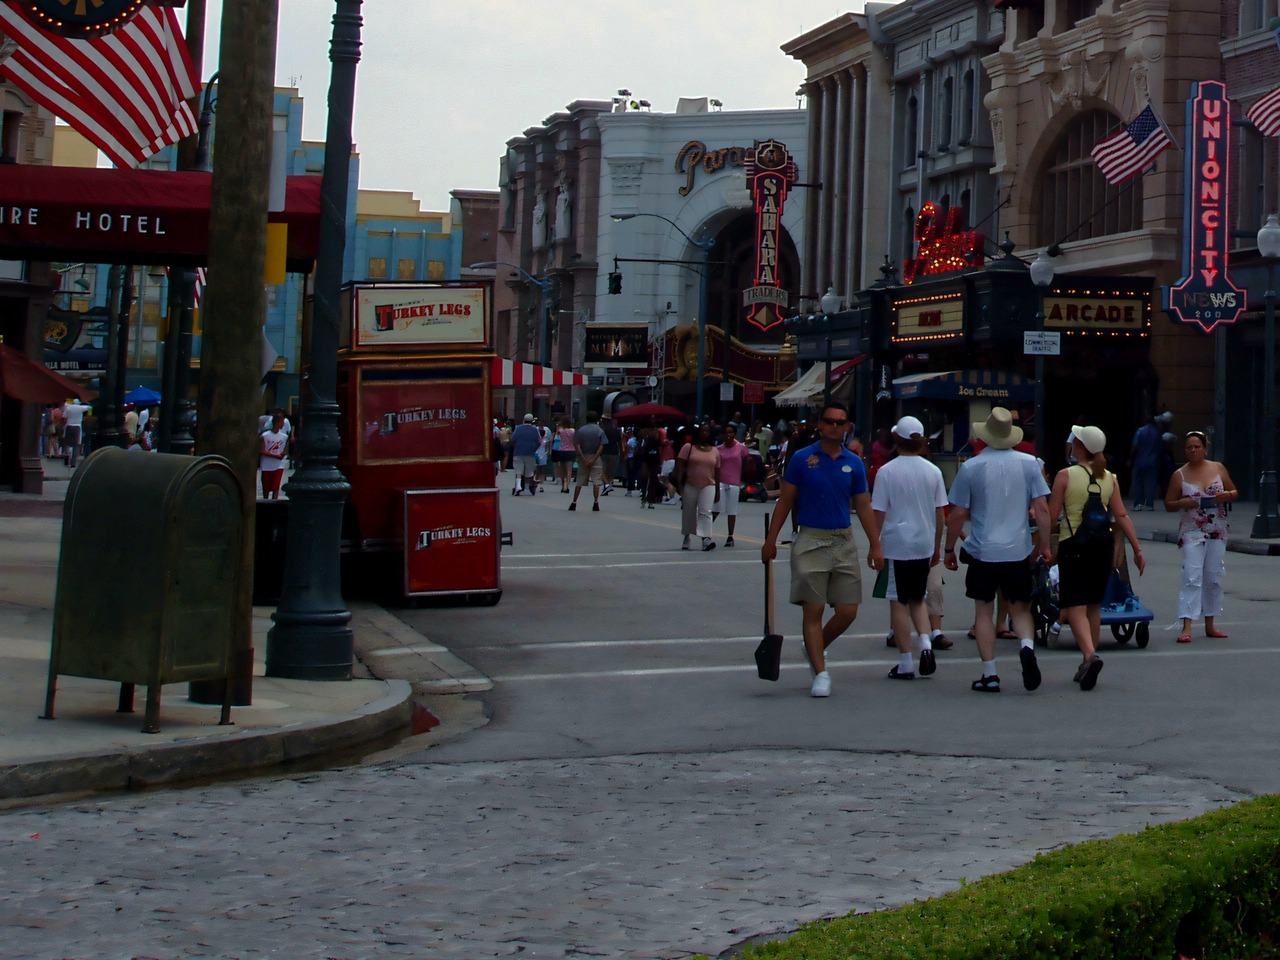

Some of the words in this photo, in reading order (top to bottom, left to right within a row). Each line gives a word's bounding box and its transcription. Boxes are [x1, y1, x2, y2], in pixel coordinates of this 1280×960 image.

[1202, 99, 1221, 200] UNION
[76, 211, 166, 235] HOTEL
[759, 178, 778, 284] SAHARA
[1200, 209, 1221, 287] CITY
[1183, 292, 1236, 308] NEWS
[377, 305, 435, 330] TURKEY
[439, 303, 472, 316] LEGS
[1048, 303, 1135, 322] ARCADE
[384, 410, 435, 432] TURKEY
[438, 408, 466, 419] LEGS
[420, 528, 464, 547] TURKEY
[466, 527, 491, 537] LEGS
